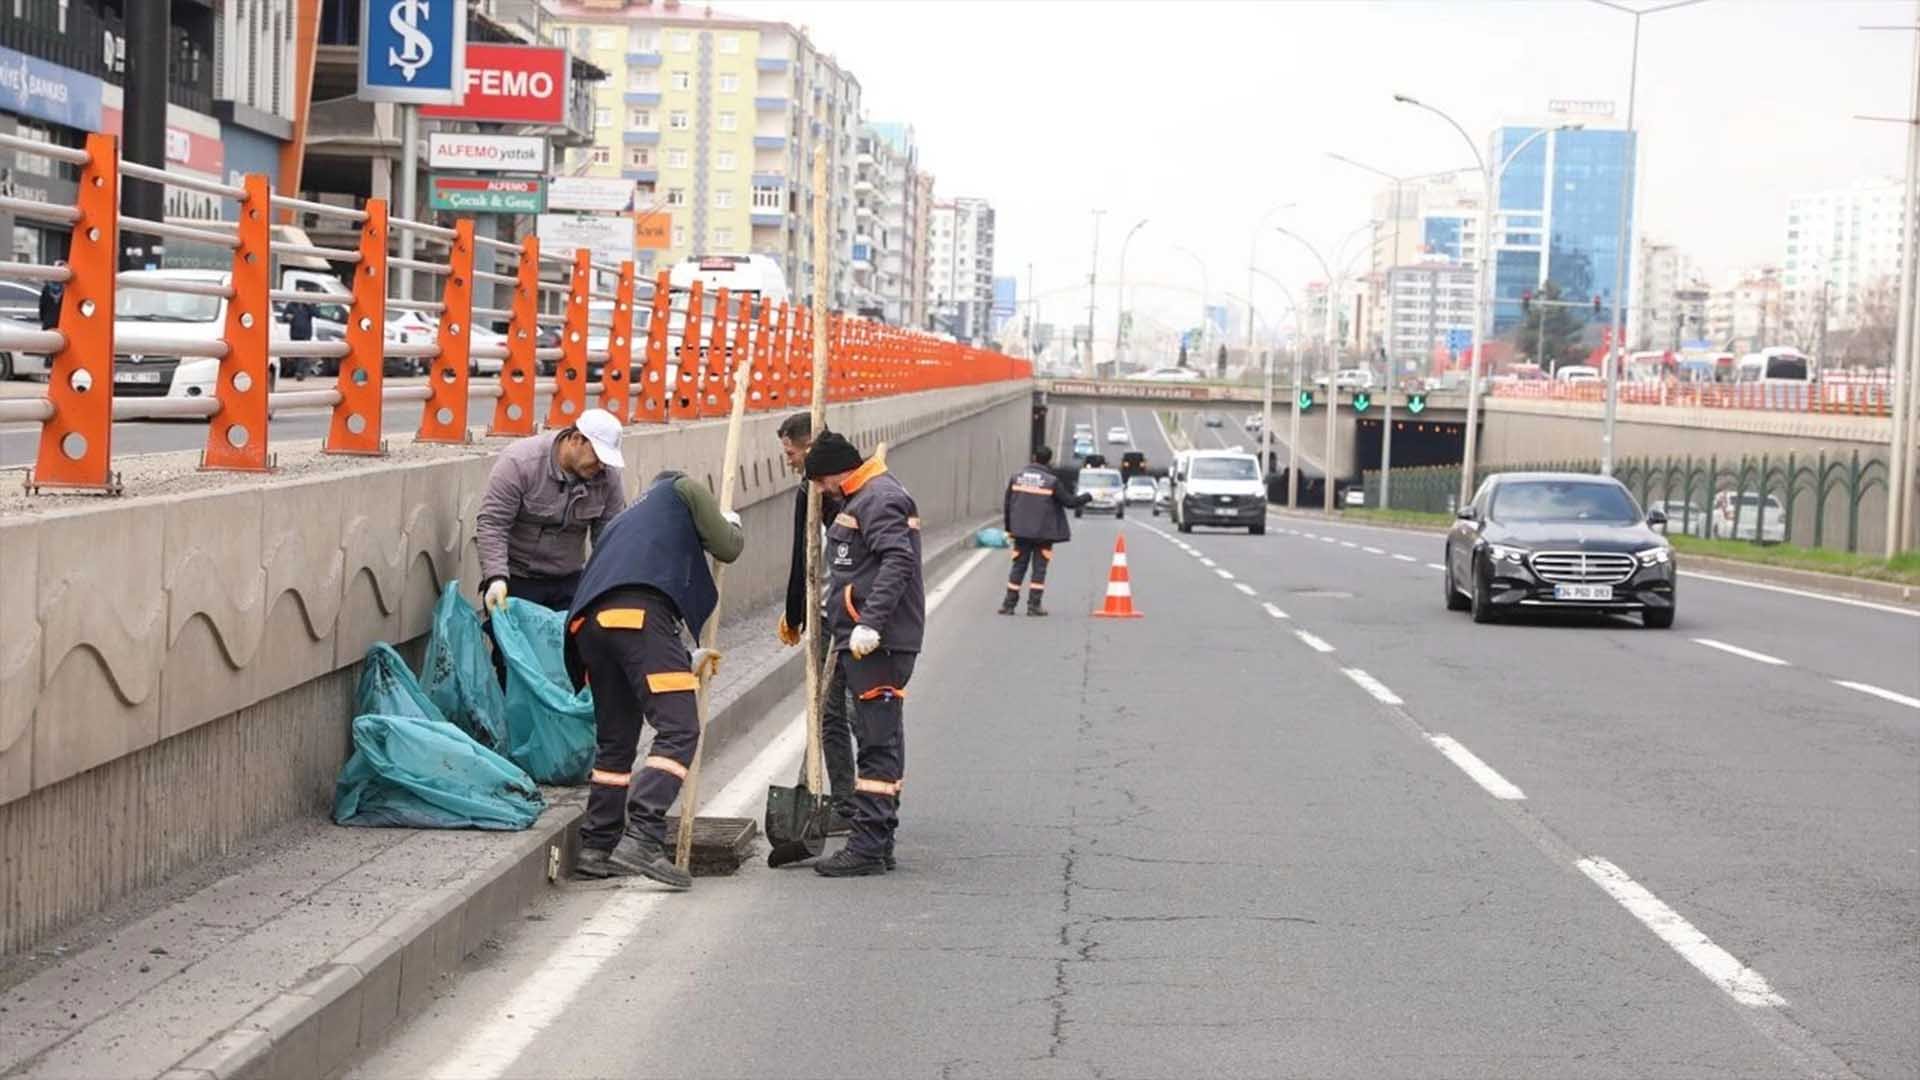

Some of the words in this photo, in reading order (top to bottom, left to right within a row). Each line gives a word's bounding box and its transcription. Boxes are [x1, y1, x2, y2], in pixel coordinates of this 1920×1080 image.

[464, 68, 554, 98] FEMO
[437, 144, 498, 159] ALFEMO
[499, 148, 536, 161] yatak
[487, 181, 529, 192] ALFEMO
[450, 192, 487, 208] Çocuk
[490, 195, 502, 207] &
[505, 195, 536, 210] Genç
